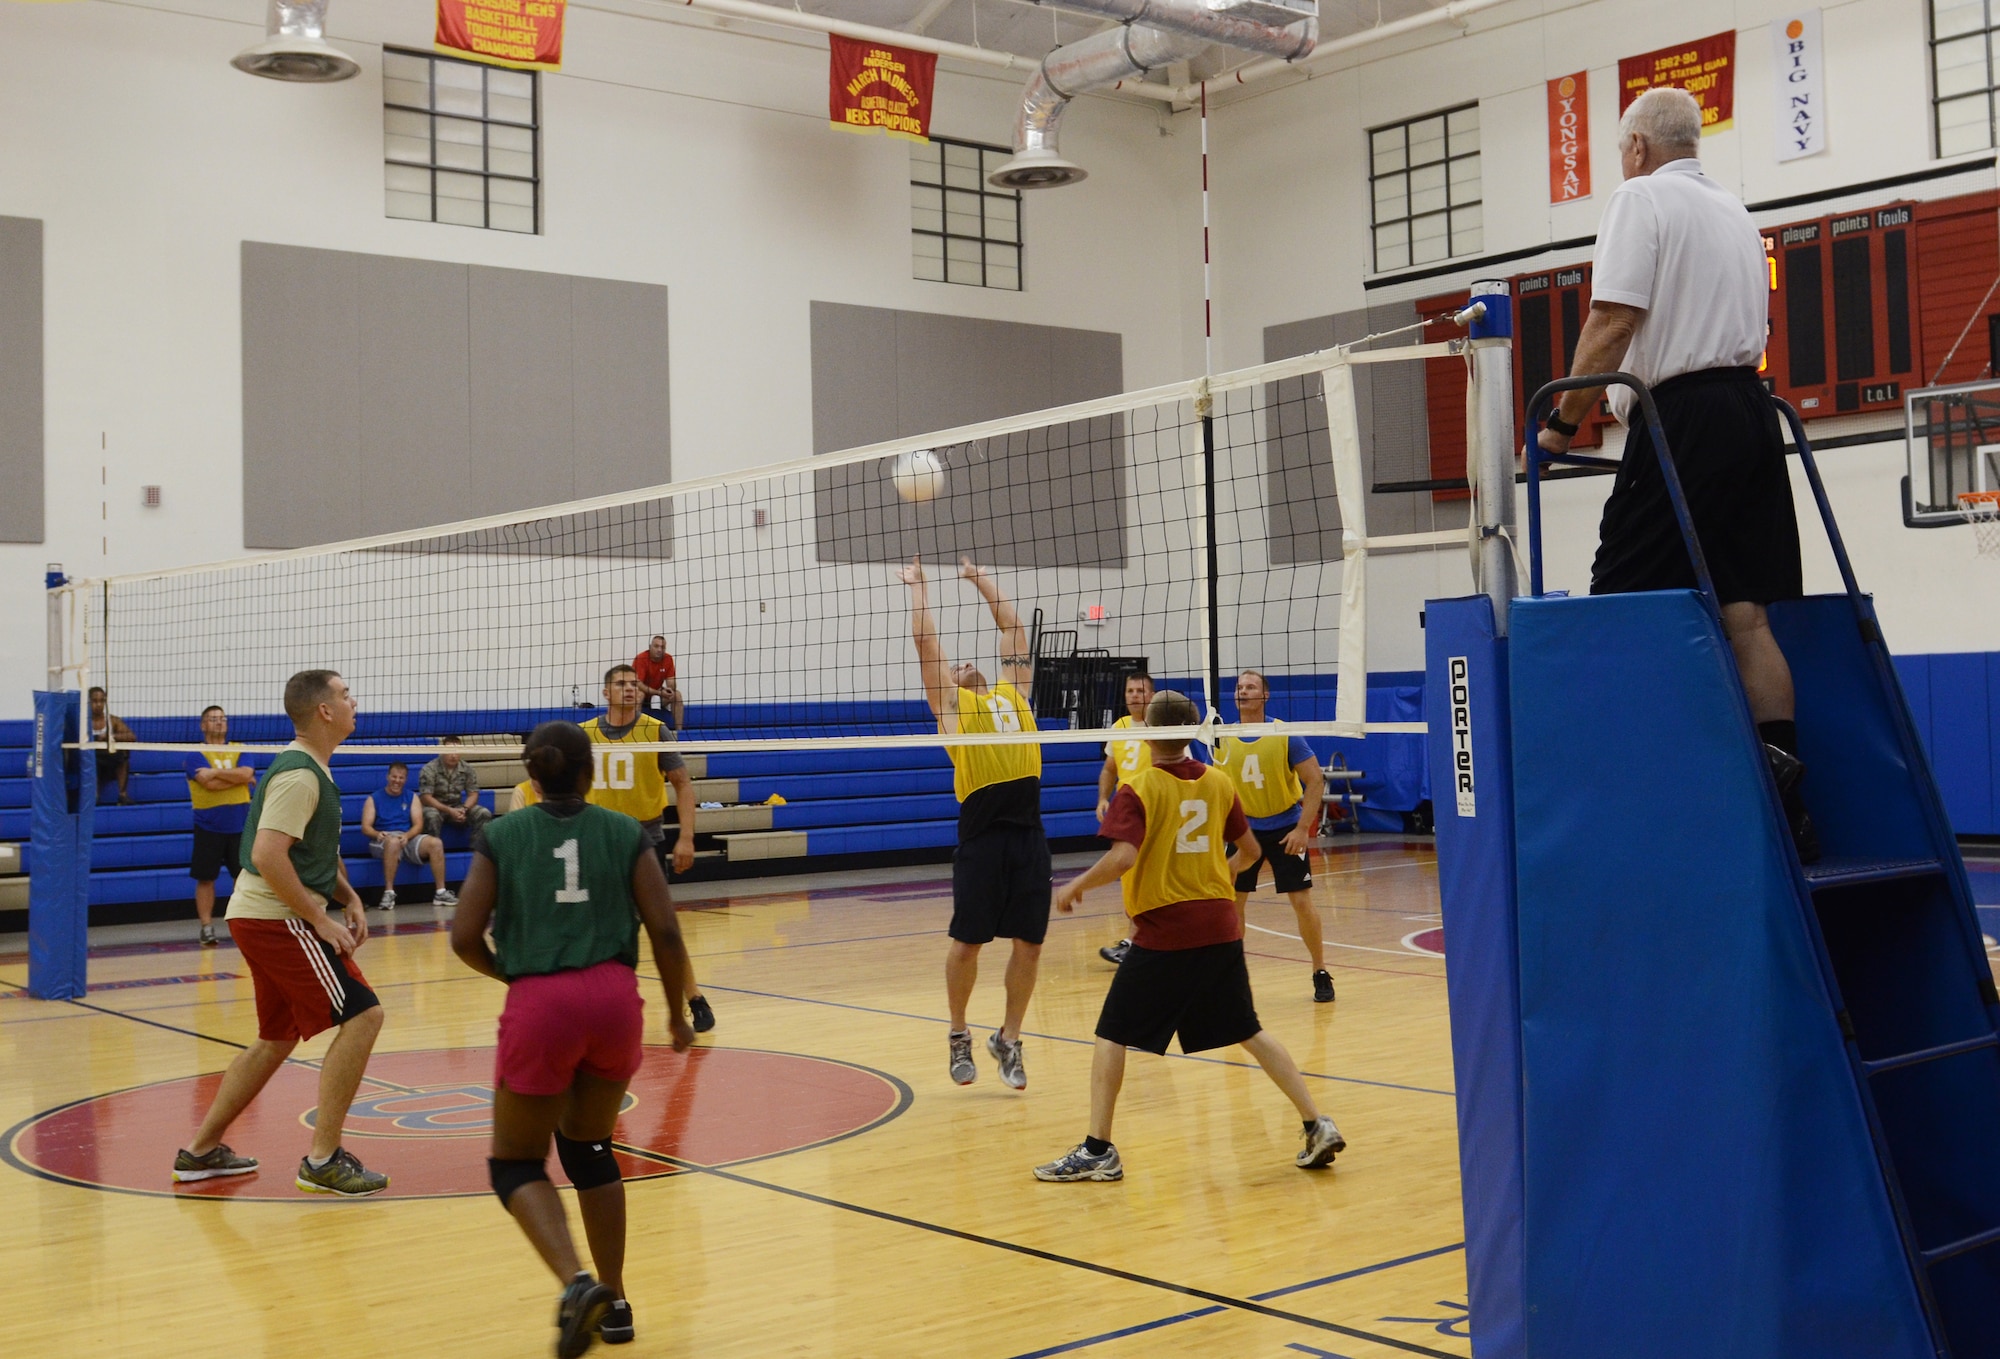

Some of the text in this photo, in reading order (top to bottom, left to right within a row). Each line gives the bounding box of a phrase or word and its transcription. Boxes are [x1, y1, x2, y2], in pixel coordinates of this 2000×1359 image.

[465, 6, 538, 31] BASKETBALL
[465, 20, 538, 45] TOURNAMENT
[472, 37, 536, 60] CHAMPIONS
[870, 49, 892, 60] 1993
[863, 57, 905, 73] ANDERSEN
[1653, 72, 1667, 83] AIR
[1670, 64, 1702, 79] STATION
[846, 68, 879, 97] MARCH
[1684, 73, 1718, 92] SHOOT
[1788, 40, 1812, 150] BIG NAVY
[872, 110, 921, 134] CHMPIONS
[1559, 97, 1580, 199] YONGSAN
[1832, 215, 1869, 237] points
[1878, 208, 1909, 228] fouls
[1783, 225, 1818, 246] player
[1519, 277, 1549, 294] points
[1556, 270, 1582, 287] fouls
[1451, 659, 1473, 793] PORTER
[1121, 740, 1141, 771] 3
[592, 752, 635, 790] 10
[1241, 754, 1265, 790] 4
[1176, 800, 1210, 853] 2
[553, 838, 590, 903] 1
